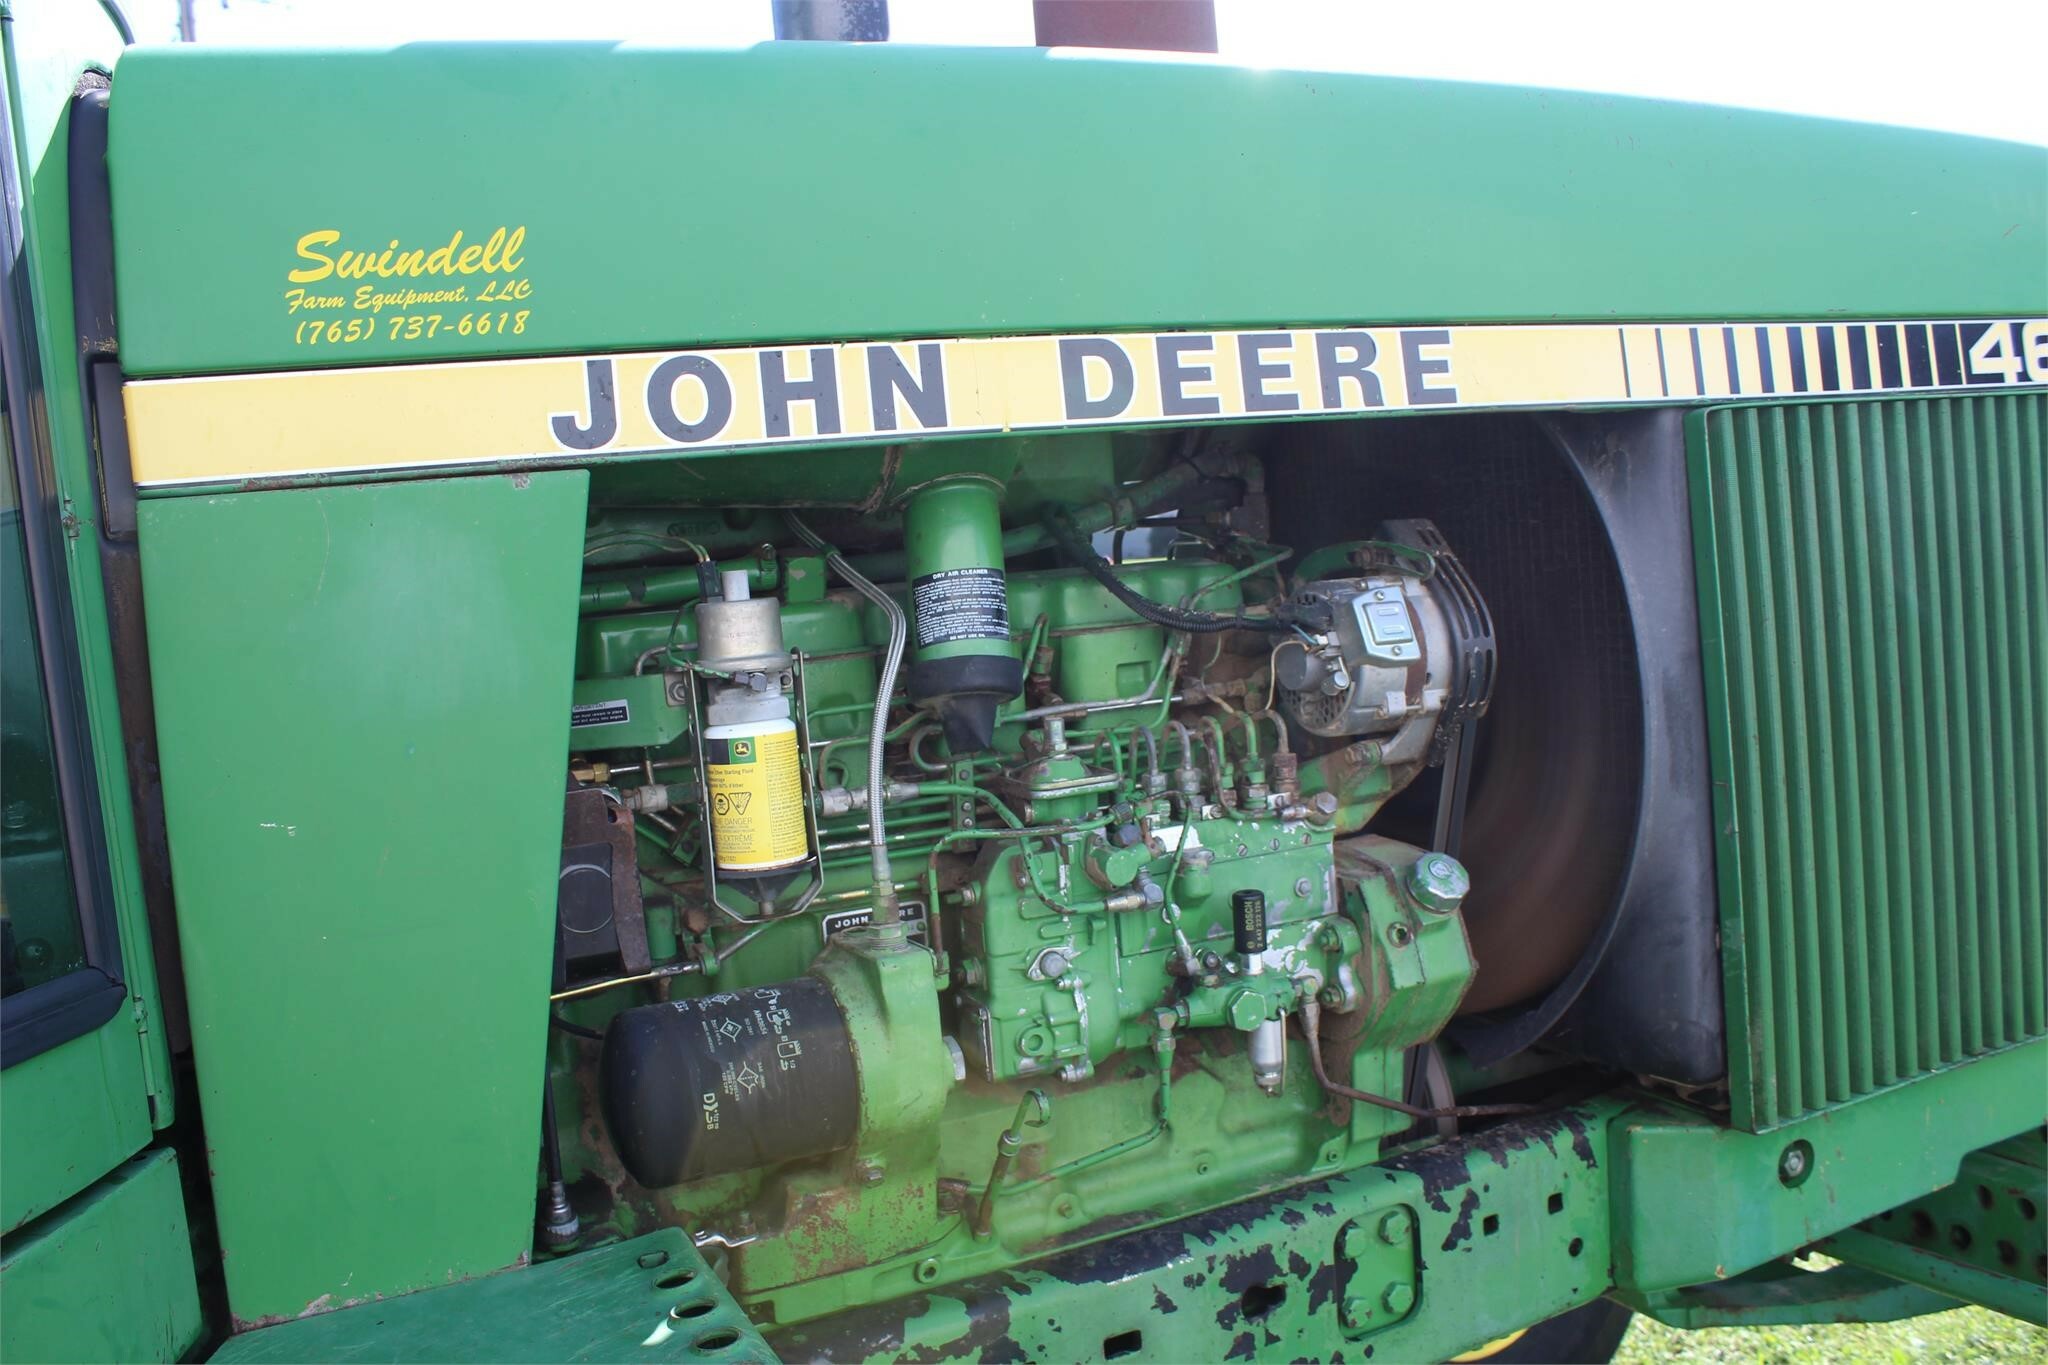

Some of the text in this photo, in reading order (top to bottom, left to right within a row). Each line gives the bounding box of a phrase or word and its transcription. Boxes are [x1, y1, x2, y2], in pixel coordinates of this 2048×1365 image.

[288, 226, 526, 283] Swindell
[285, 288, 346, 315] Farm
[476, 278, 533, 302] LLC
[295, 310, 531, 345] (765) 737-6618
[551, 330, 1458, 450] JOHN DEERE
[835, 915, 869, 929] JOHN
[1244, 901, 1254, 931] BOSCH
